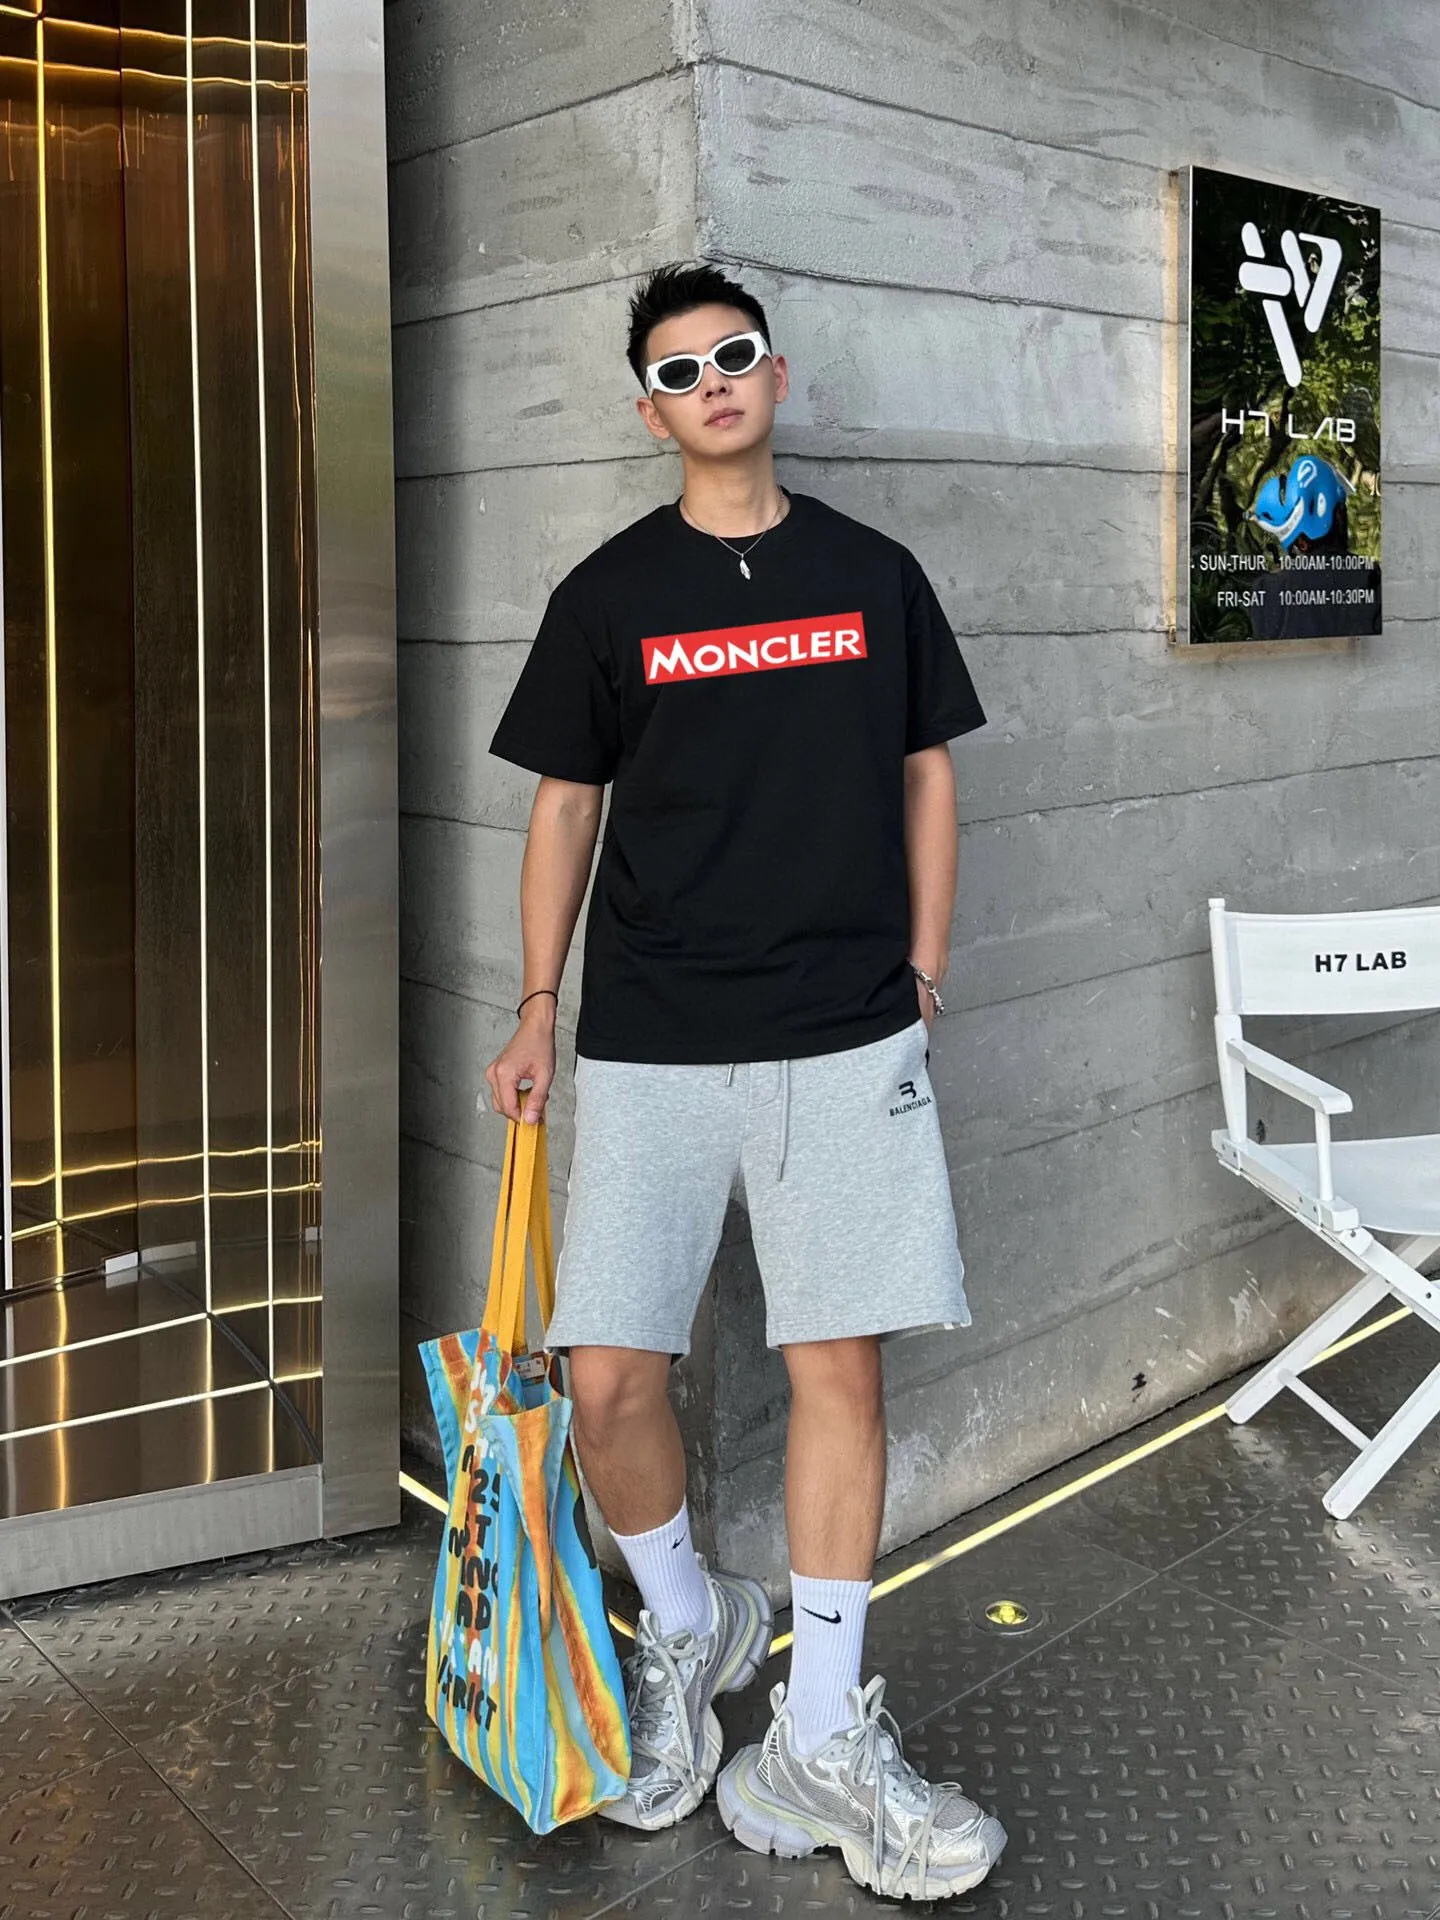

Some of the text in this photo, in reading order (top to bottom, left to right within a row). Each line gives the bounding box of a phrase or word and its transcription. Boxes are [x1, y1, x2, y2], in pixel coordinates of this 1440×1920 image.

[1221, 408, 1356, 443] H7 LAB
[1200, 554, 1375, 571] SUN-THUR 10:00AM-10:00PM
[1217, 589, 1375, 607] FRI-SAT 10:00AM-10:30PM
[1315, 951, 1407, 972] H7 LAB
[889, 1096, 932, 1117] BALENCIAGA
